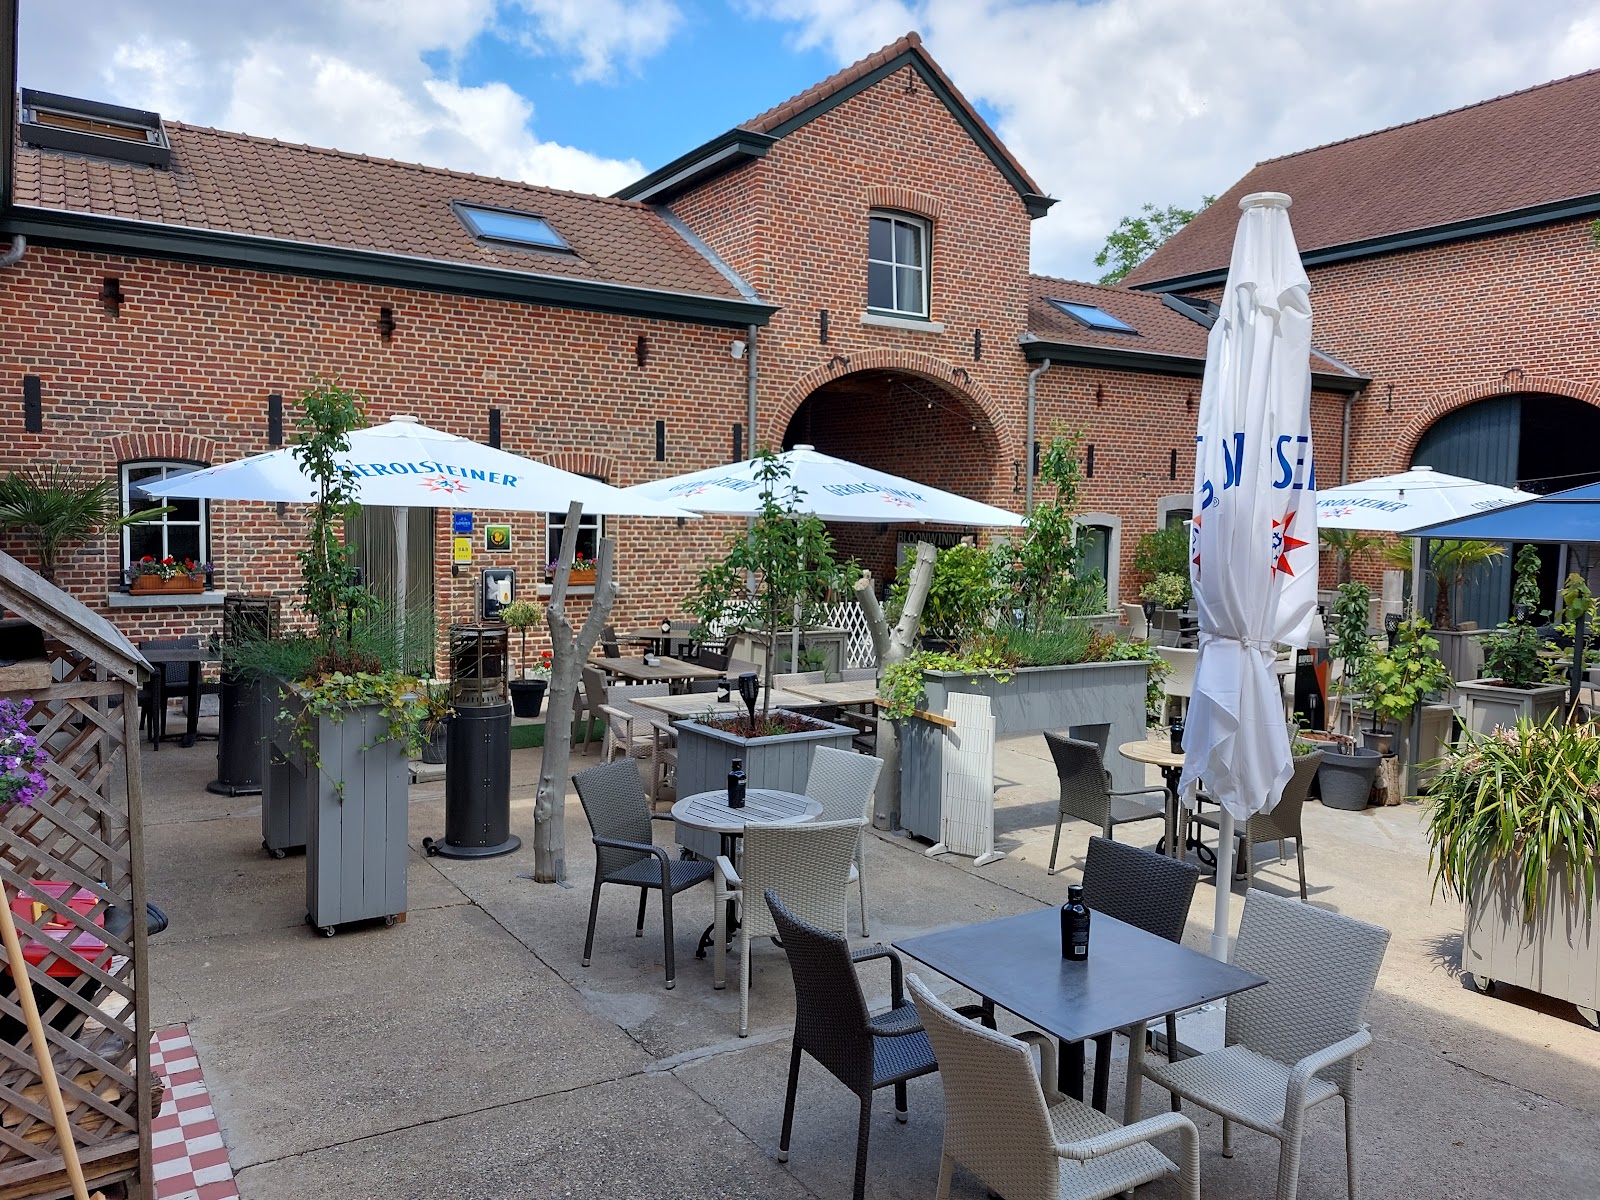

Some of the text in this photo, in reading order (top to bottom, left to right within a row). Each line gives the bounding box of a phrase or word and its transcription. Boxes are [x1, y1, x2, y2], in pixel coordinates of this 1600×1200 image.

[668, 477, 760, 493] GEROTEINER
[1315, 498, 1409, 513] EROLSTEINER
[897, 531, 963, 546] BLOONWINNI
